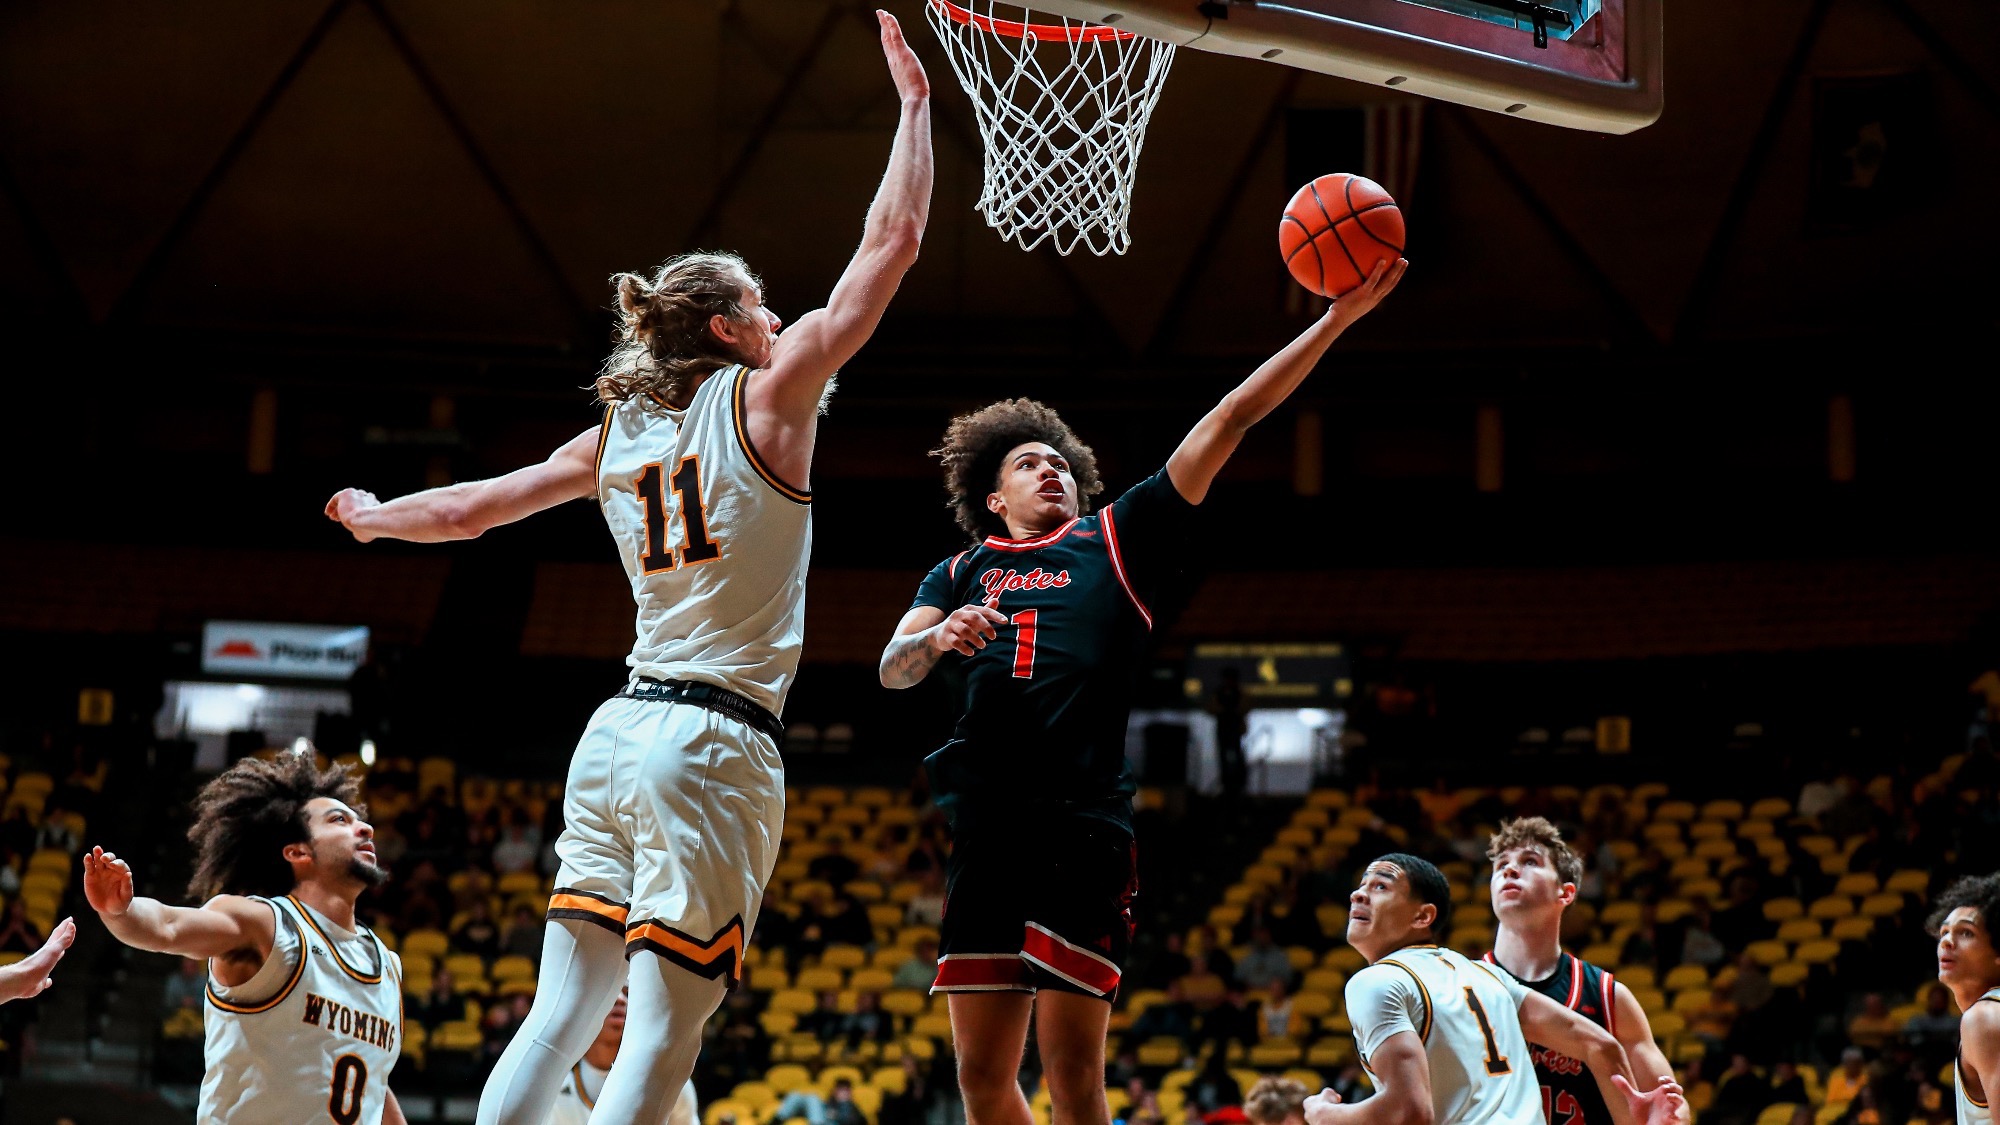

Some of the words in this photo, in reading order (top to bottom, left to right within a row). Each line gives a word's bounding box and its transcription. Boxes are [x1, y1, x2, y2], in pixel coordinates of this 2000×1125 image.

[633, 454, 722, 577] 11
[980, 568, 1071, 604] Yotes
[1011, 608, 1038, 679] 1
[302, 992, 396, 1053] WYOMING
[1463, 986, 1513, 1077] 1
[327, 1052, 368, 1125] 0
